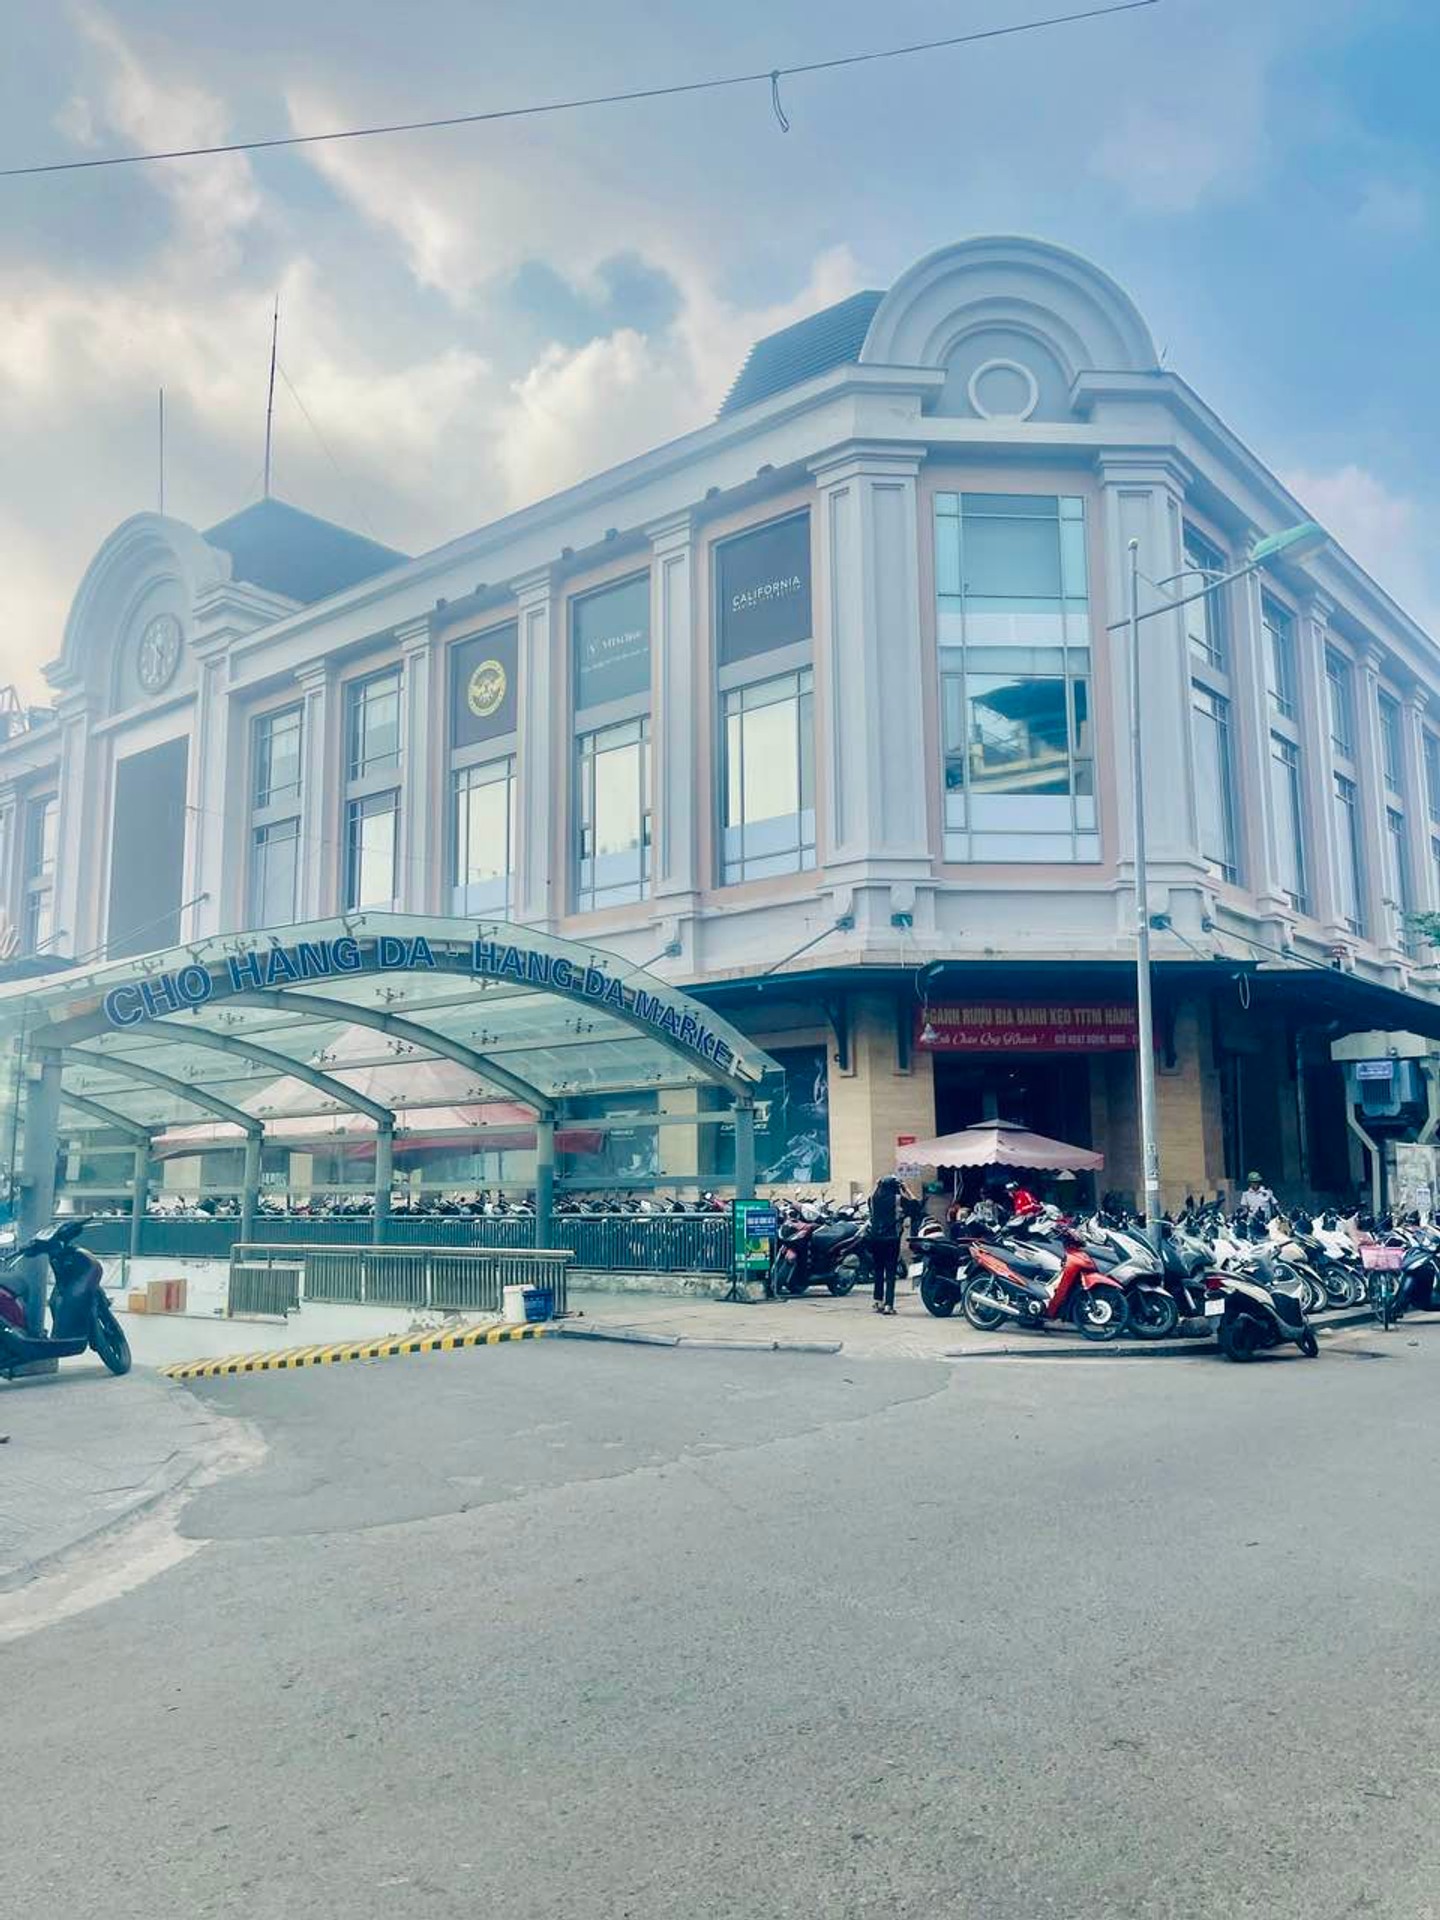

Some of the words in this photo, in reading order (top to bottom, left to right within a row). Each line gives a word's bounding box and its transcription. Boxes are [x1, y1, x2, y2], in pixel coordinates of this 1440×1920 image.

[732, 576, 801, 607] CALIFORNIA
[228, 936, 362, 992] HÀNG
[378, 936, 436, 969] DA
[471, 938, 574, 991] HANG
[583, 968, 626, 1008] DA
